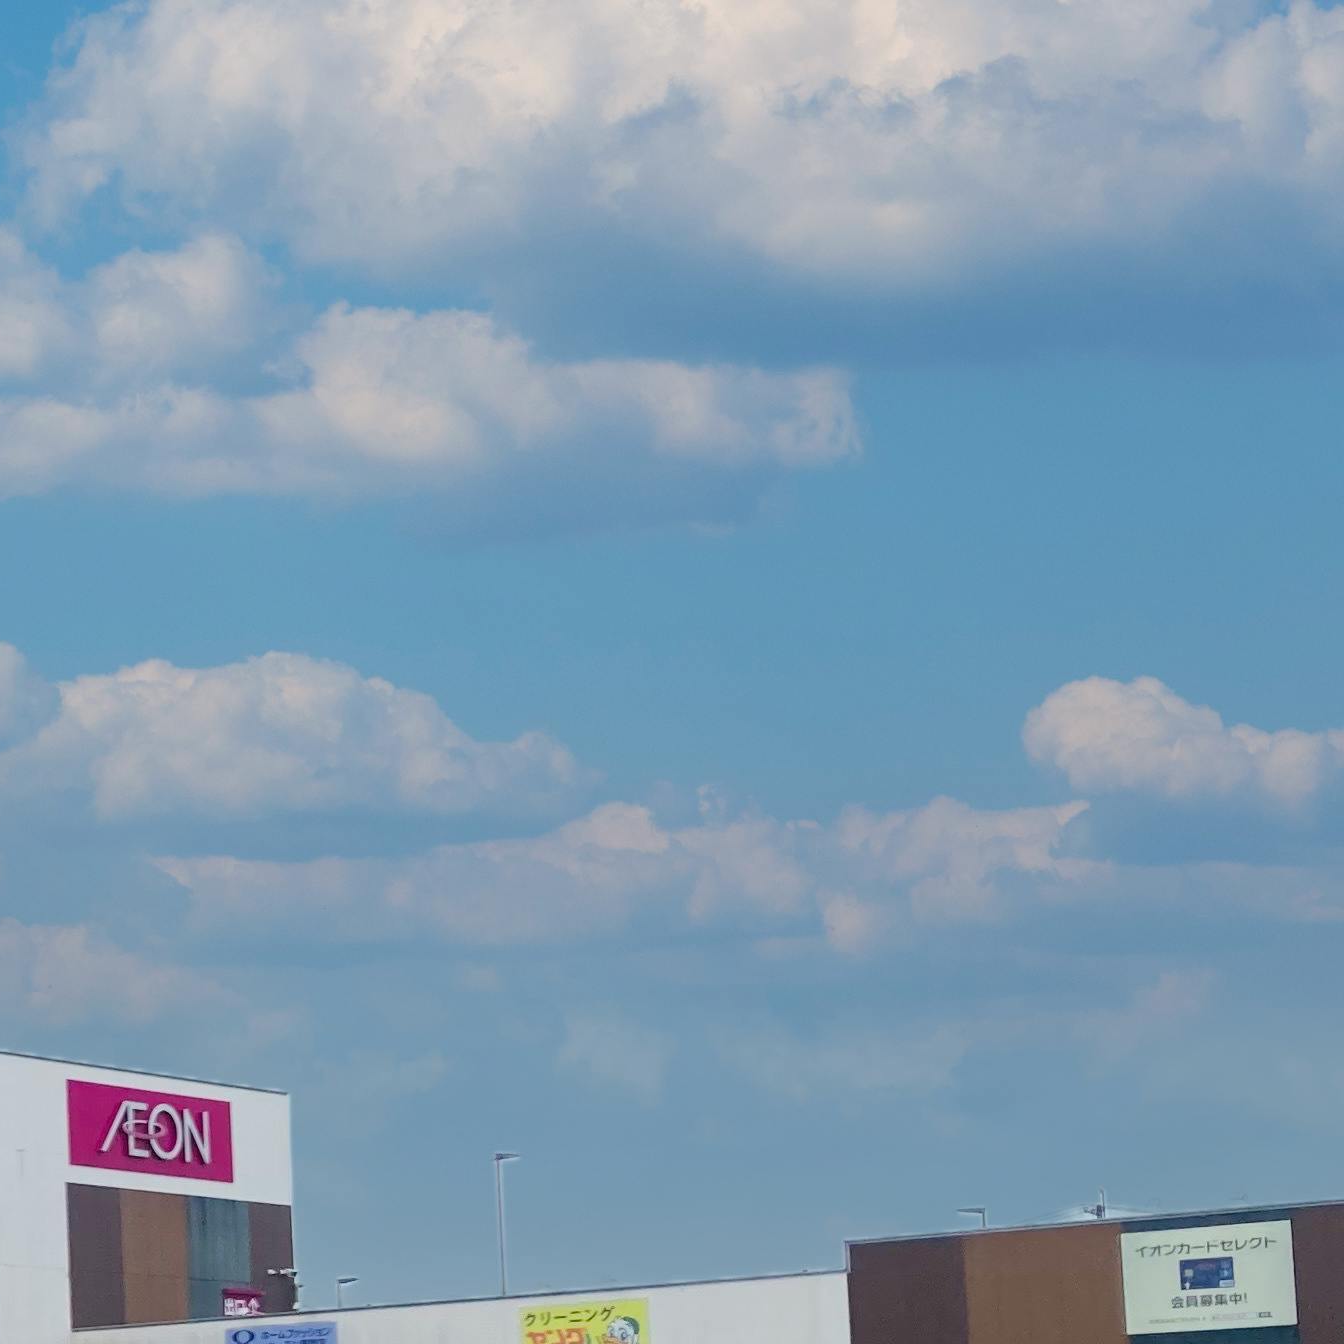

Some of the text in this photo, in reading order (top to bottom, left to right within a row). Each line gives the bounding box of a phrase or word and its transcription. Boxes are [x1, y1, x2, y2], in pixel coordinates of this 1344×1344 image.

[1135, 1236, 1278, 1258] イオンカードセレクト
[524, 1305, 615, 1327] クリーニング
